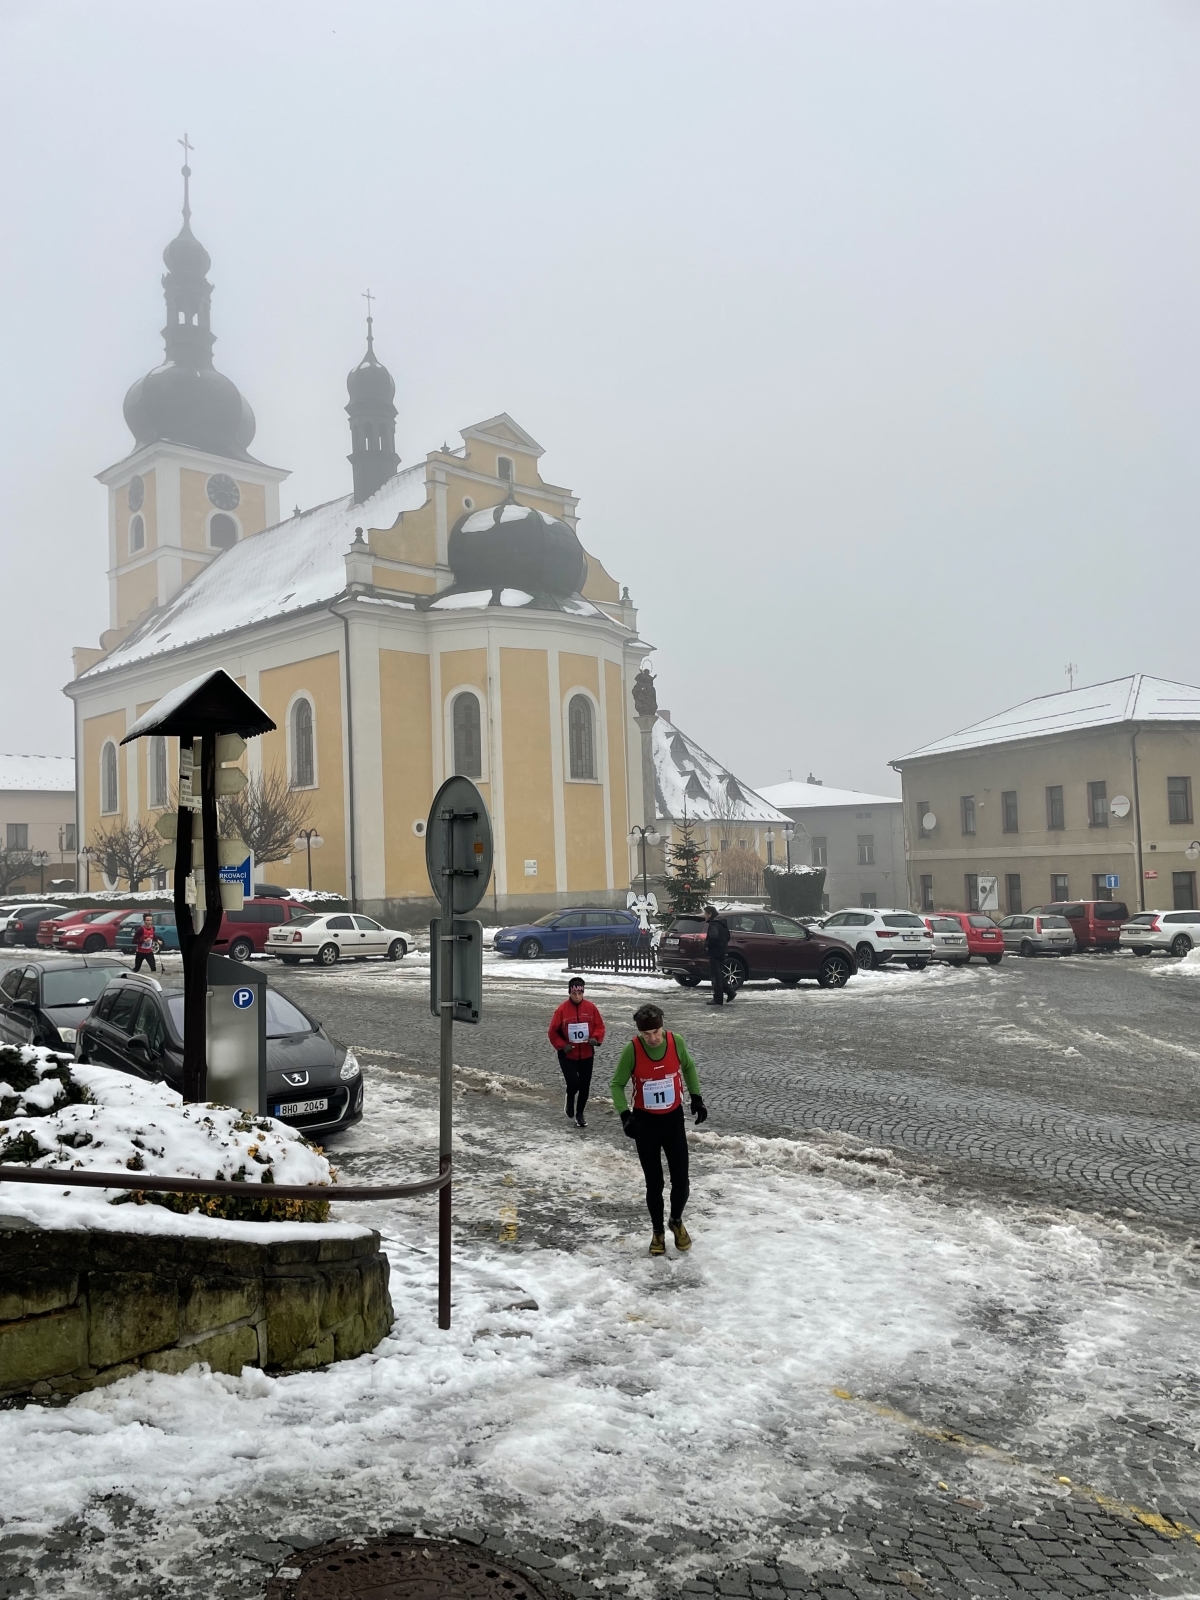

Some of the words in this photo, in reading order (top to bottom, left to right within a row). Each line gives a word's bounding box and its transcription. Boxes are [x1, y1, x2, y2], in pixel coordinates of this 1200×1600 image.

[239, 992, 249, 1005] P
[573, 1031, 584, 1039] 10
[653, 1092, 665, 1104] 11
[304, 1101, 324, 1111] 2045
